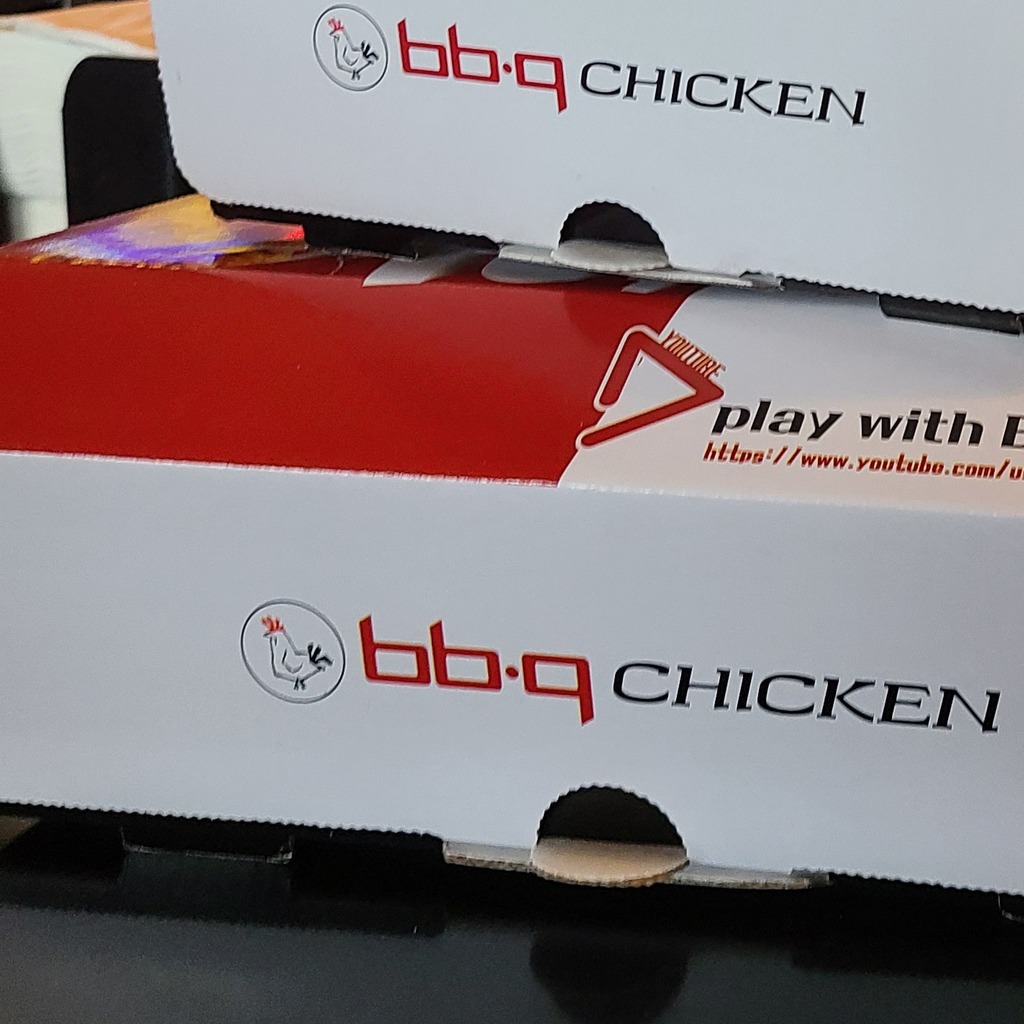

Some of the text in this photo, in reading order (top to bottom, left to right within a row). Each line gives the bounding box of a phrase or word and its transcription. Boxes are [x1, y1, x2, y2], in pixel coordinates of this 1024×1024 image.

[579, 60, 867, 127] CHICKEN
[710, 398, 844, 442] play
[858, 406, 985, 447] with
[611, 660, 1000, 734] CHICKEN
